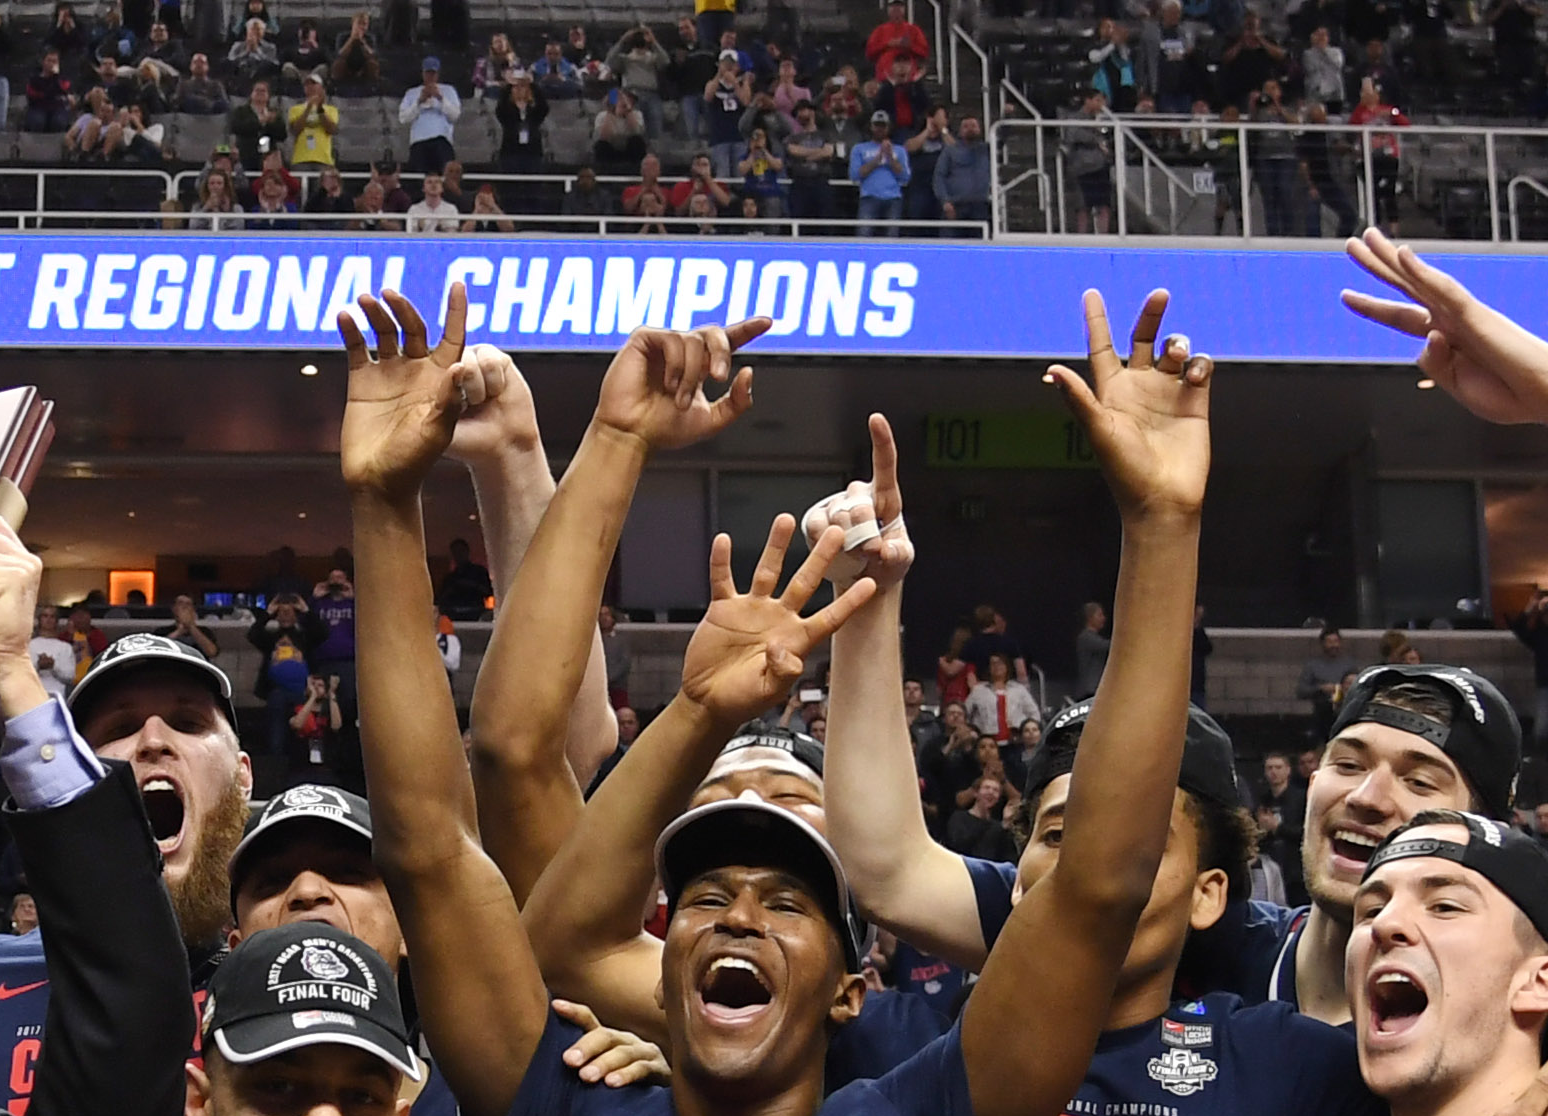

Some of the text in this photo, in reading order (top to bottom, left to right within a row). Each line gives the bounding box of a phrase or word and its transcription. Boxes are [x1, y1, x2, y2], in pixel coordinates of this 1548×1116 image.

[438, 256, 919, 337] CHAMPIONS
[934, 419, 1094, 461] 101 10
[278, 984, 370, 1011] FINAL FOUR
[1066, 1100, 1098, 1116] ONAL
